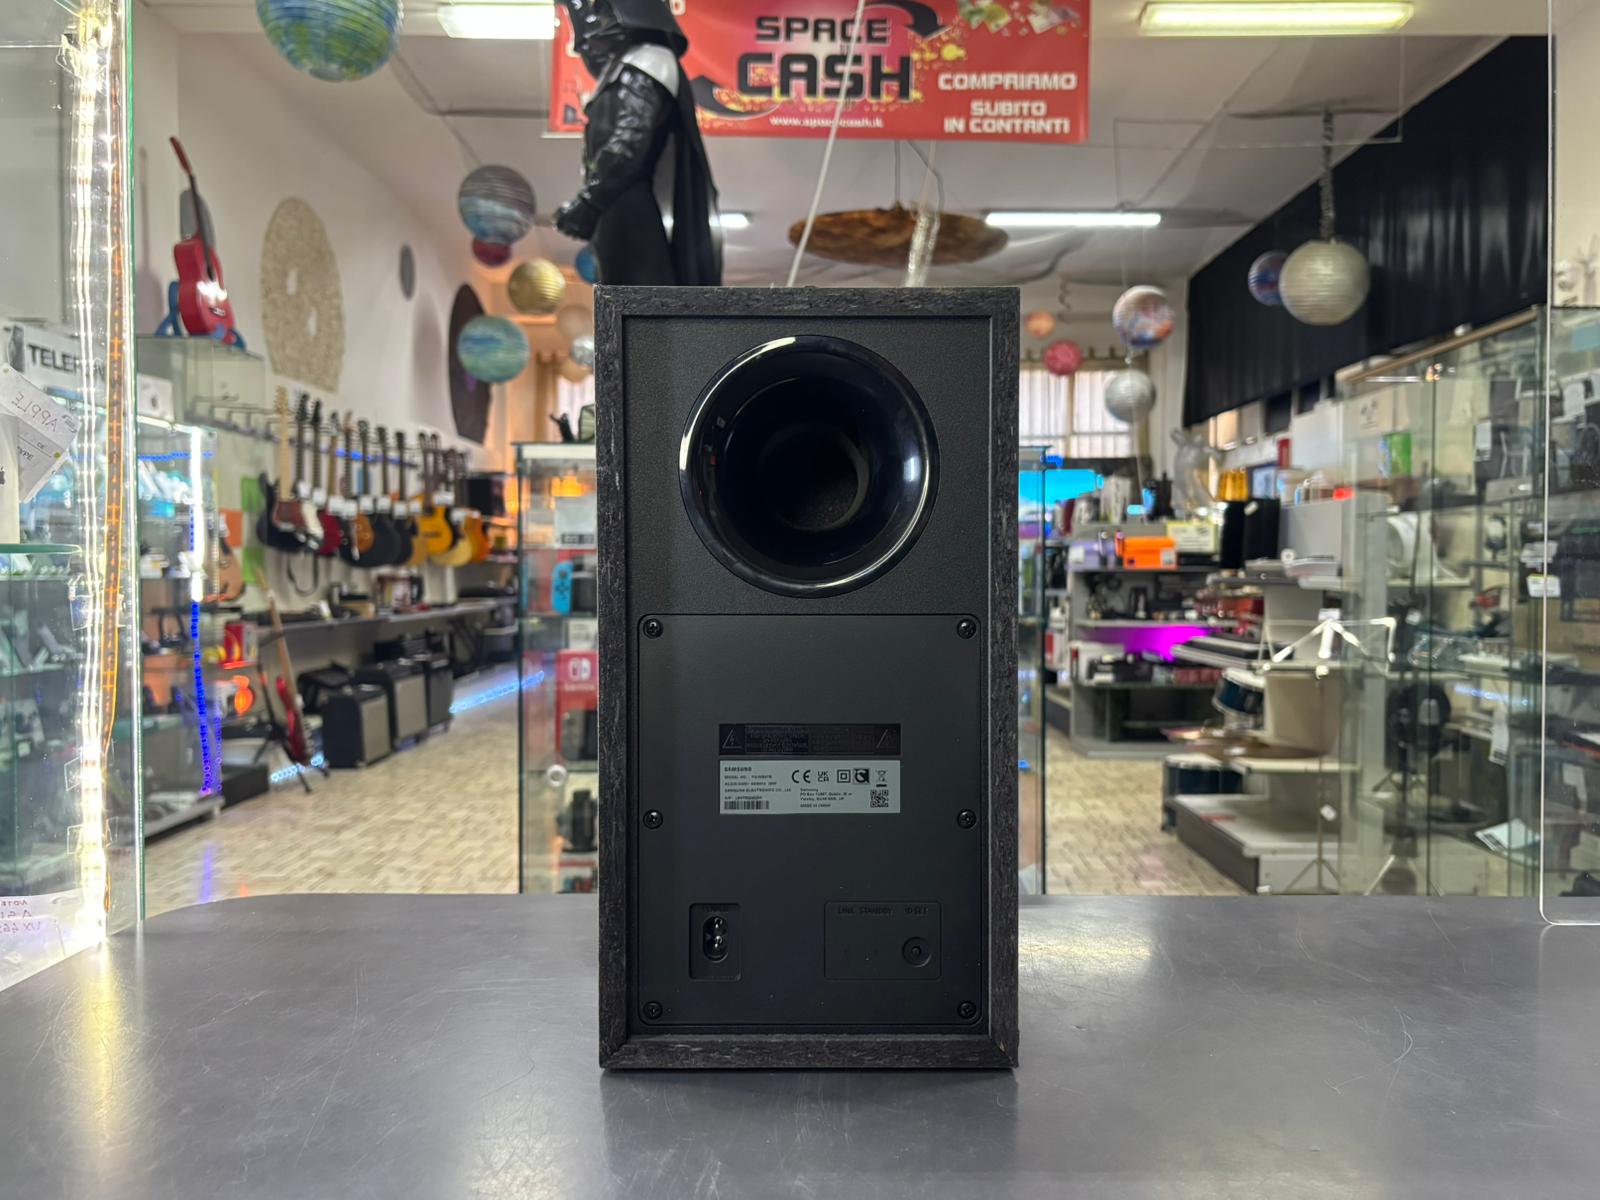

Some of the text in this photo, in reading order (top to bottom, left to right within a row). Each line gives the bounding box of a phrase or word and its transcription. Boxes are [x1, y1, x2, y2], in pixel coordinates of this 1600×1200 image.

[756, 16, 888, 43] SPACE
[738, 53, 911, 99] CASH
[938, 72, 1078, 90] COMPRIAMO
[970, 100, 1047, 116] SUBITO
[944, 117, 1070, 134] IN CONTANTI
